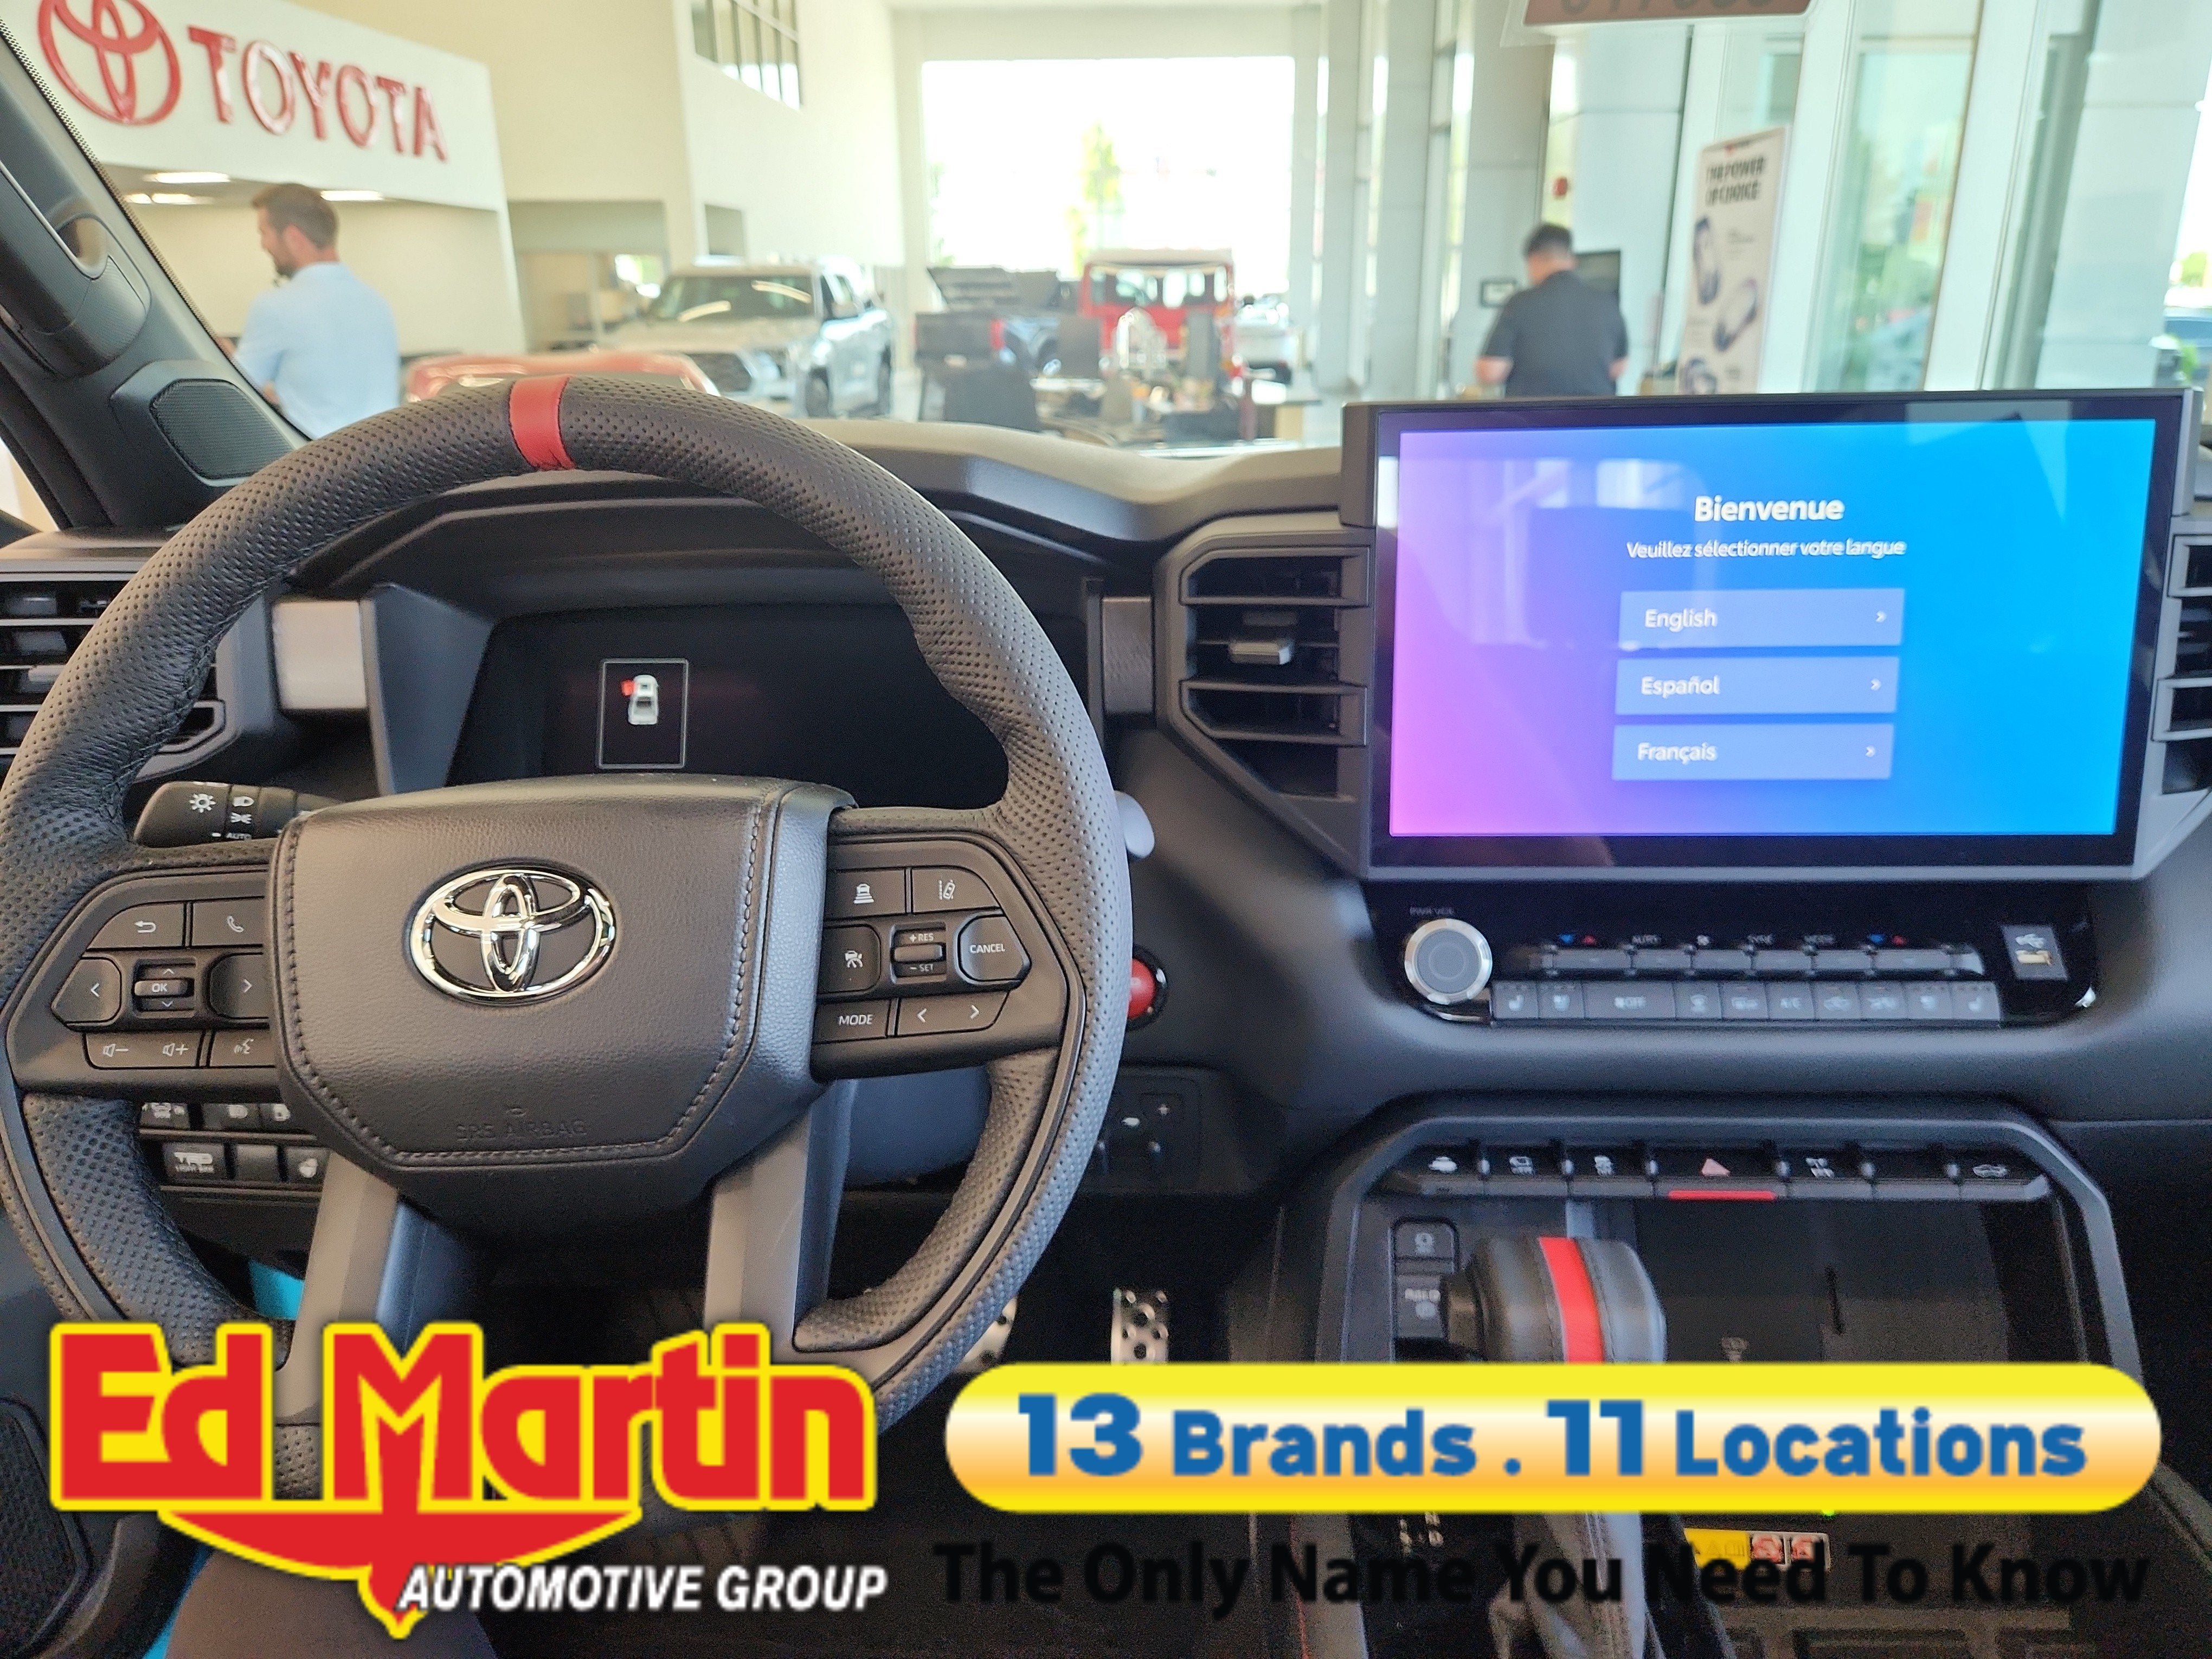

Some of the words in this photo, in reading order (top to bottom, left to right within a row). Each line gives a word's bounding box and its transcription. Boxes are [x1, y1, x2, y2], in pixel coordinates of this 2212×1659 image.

[188, 25, 448, 163] TOYOTA
[1694, 495, 1844, 522] Bienvenue
[1626, 541, 1692, 558] Veuillez
[1695, 539, 1797, 558] sélectionner
[1800, 540, 1843, 556] votre
[1846, 538, 1907, 559] langue
[1644, 608, 1718, 632] English
[1641, 675, 1720, 698] Español
[1637, 742, 1718, 764] Français
[969, 942, 1006, 954] CANCEL
[920, 963, 934, 972] SET
[151, 983, 168, 993] OK
[838, 1014, 874, 1025] MODE
